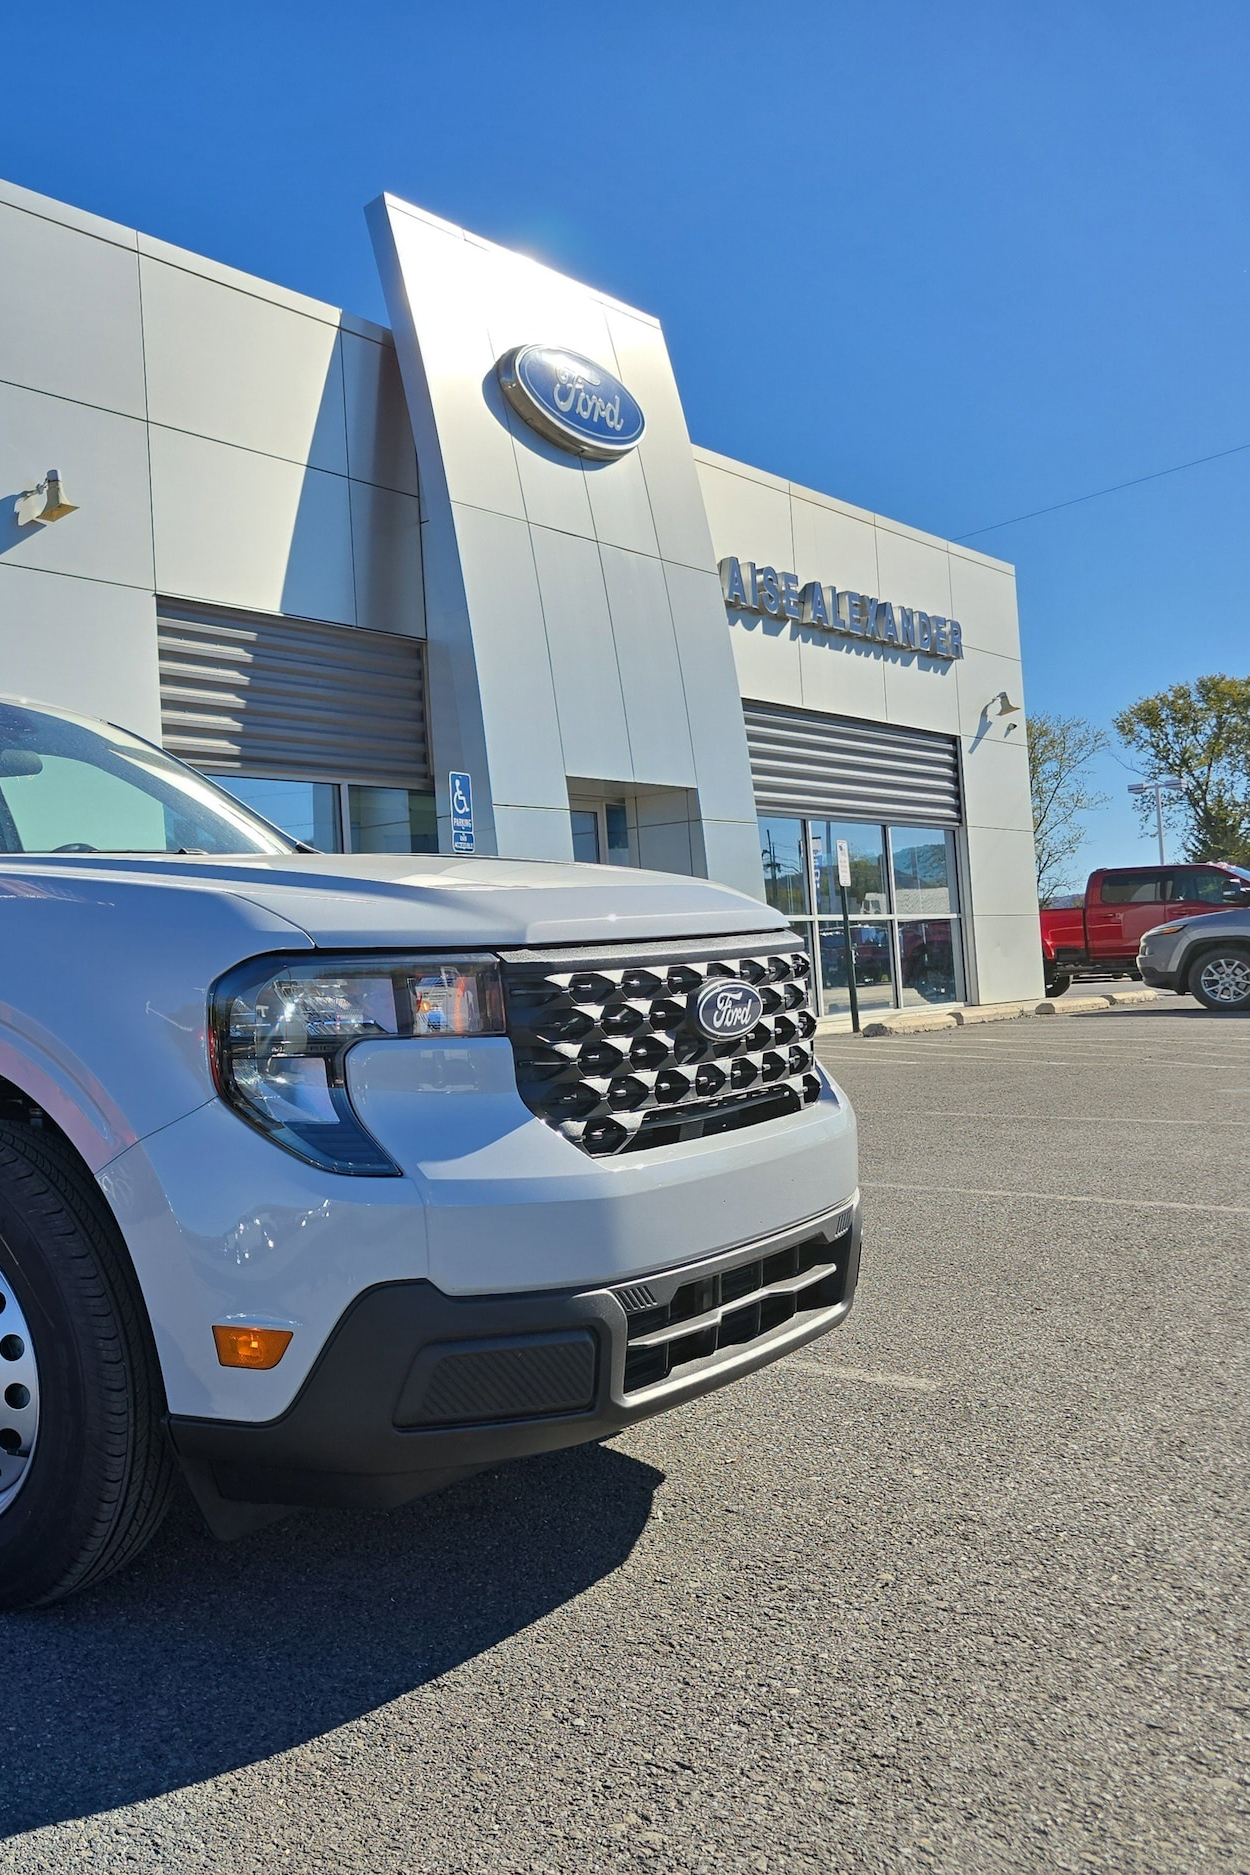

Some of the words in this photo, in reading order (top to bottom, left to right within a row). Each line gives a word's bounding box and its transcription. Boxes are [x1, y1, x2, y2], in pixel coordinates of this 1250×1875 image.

[554, 366, 625, 431] Ford
[801, 581, 964, 660] ALEXANDER
[713, 990, 752, 1028] Ford
